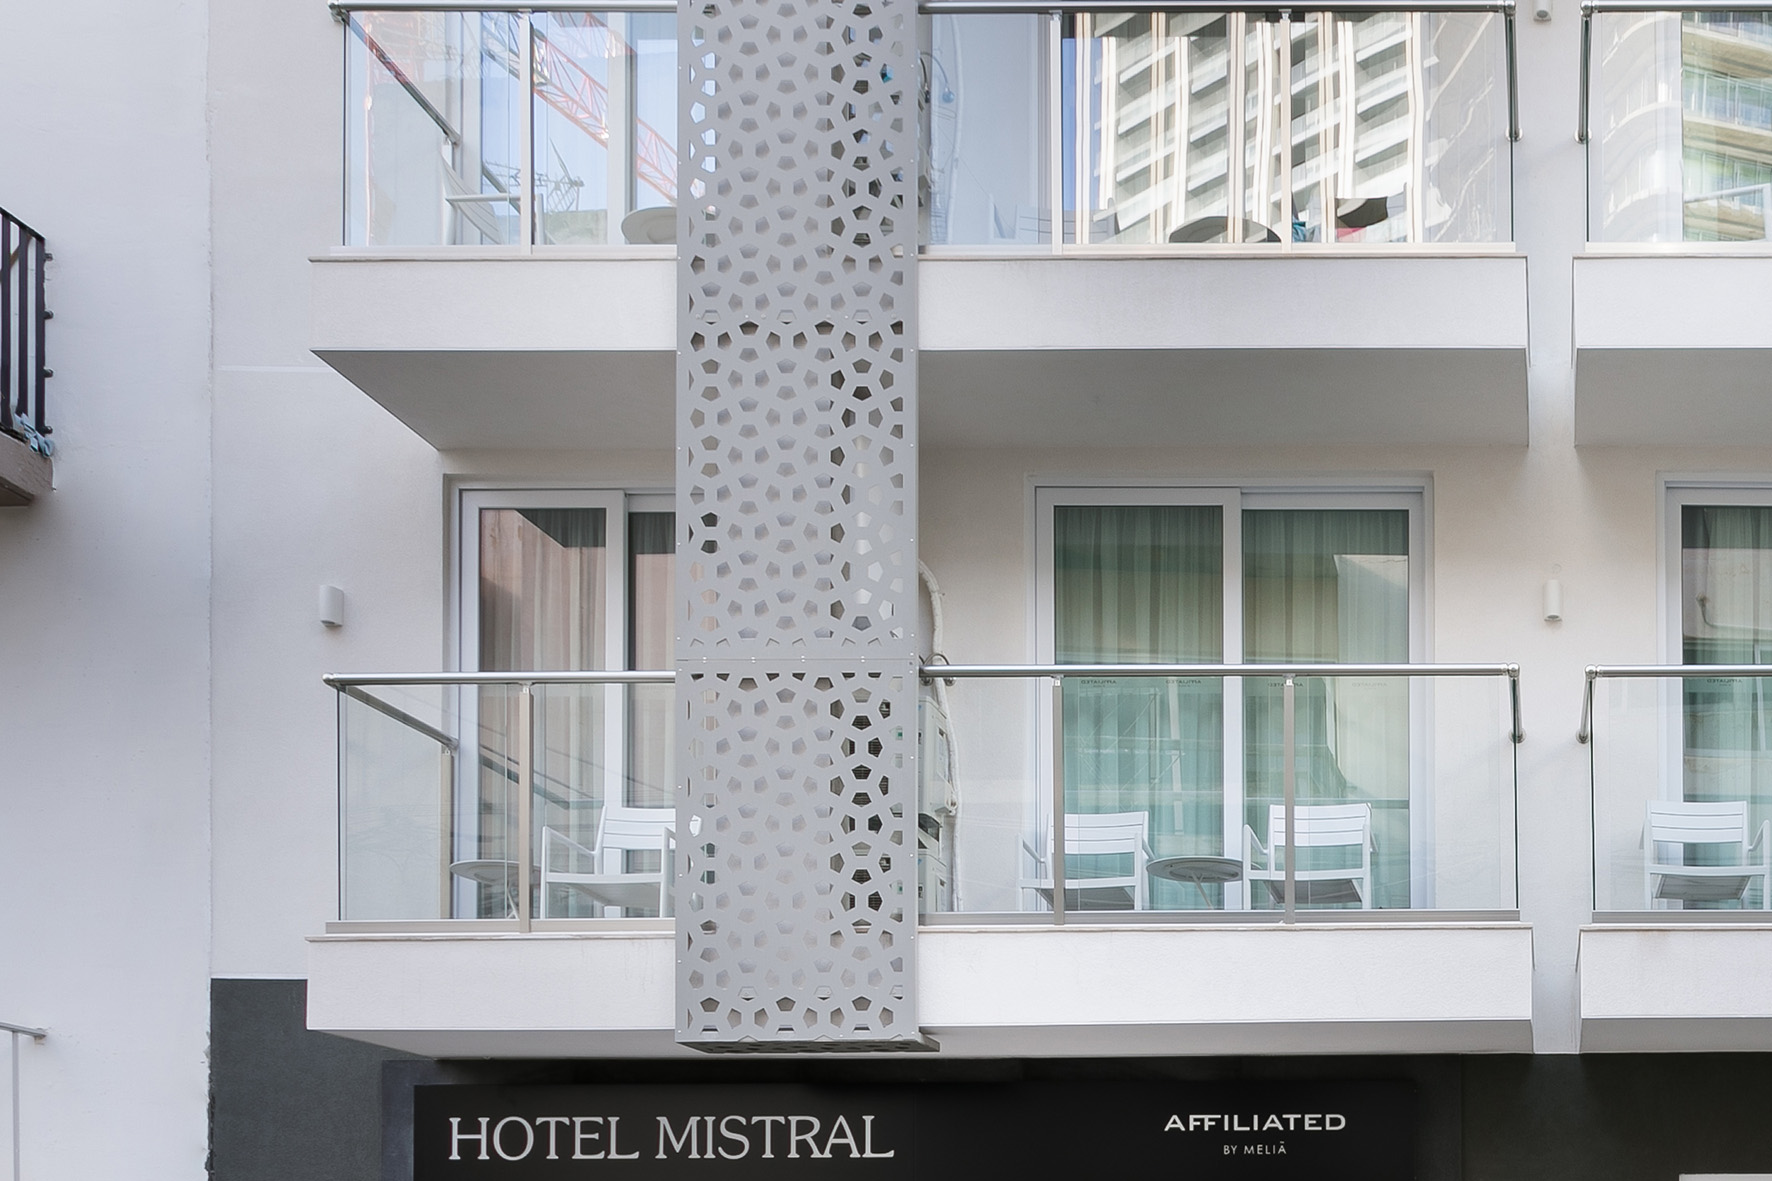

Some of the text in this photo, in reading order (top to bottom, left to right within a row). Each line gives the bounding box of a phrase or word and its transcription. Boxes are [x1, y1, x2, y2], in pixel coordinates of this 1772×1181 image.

[1163, 1113, 1346, 1132] AFFILIATED
[449, 1114, 894, 1161] HOTEL MISTRAL
[1223, 1144, 1237, 1155] BY
